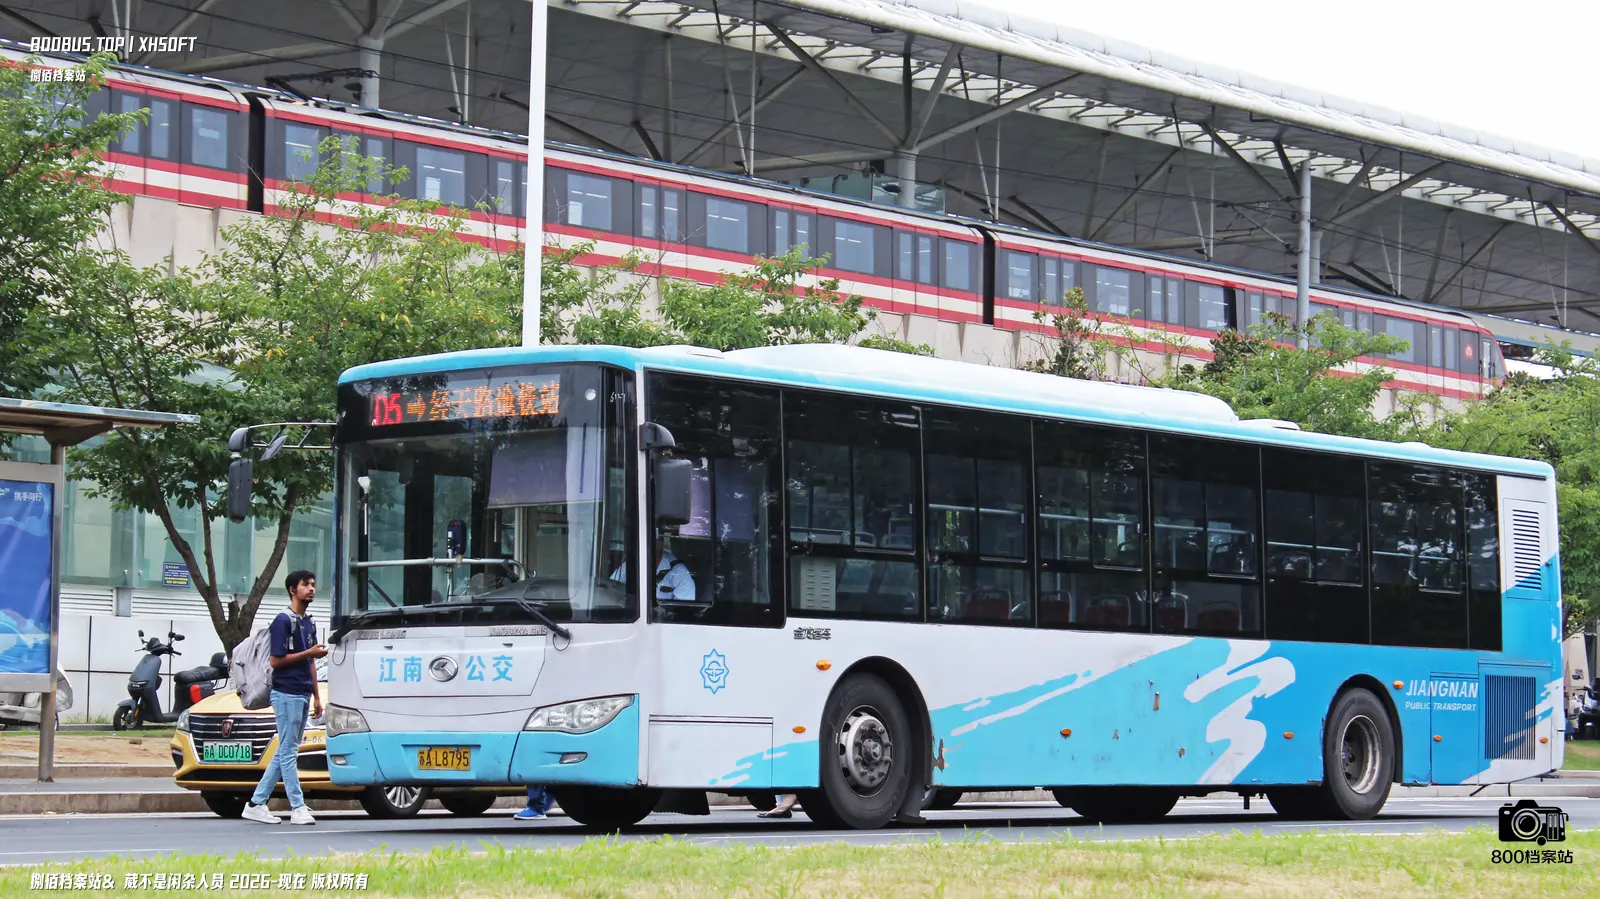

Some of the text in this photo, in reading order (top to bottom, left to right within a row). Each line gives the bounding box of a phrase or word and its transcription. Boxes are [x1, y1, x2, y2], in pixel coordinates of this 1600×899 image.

[429, 380, 561, 421] 经天路地铁站
[379, 655, 513, 682] 江南 公交
[1406, 679, 1479, 698] JIANGNAN
[1404, 701, 1477, 711] PUBLIC TRANSPORT
